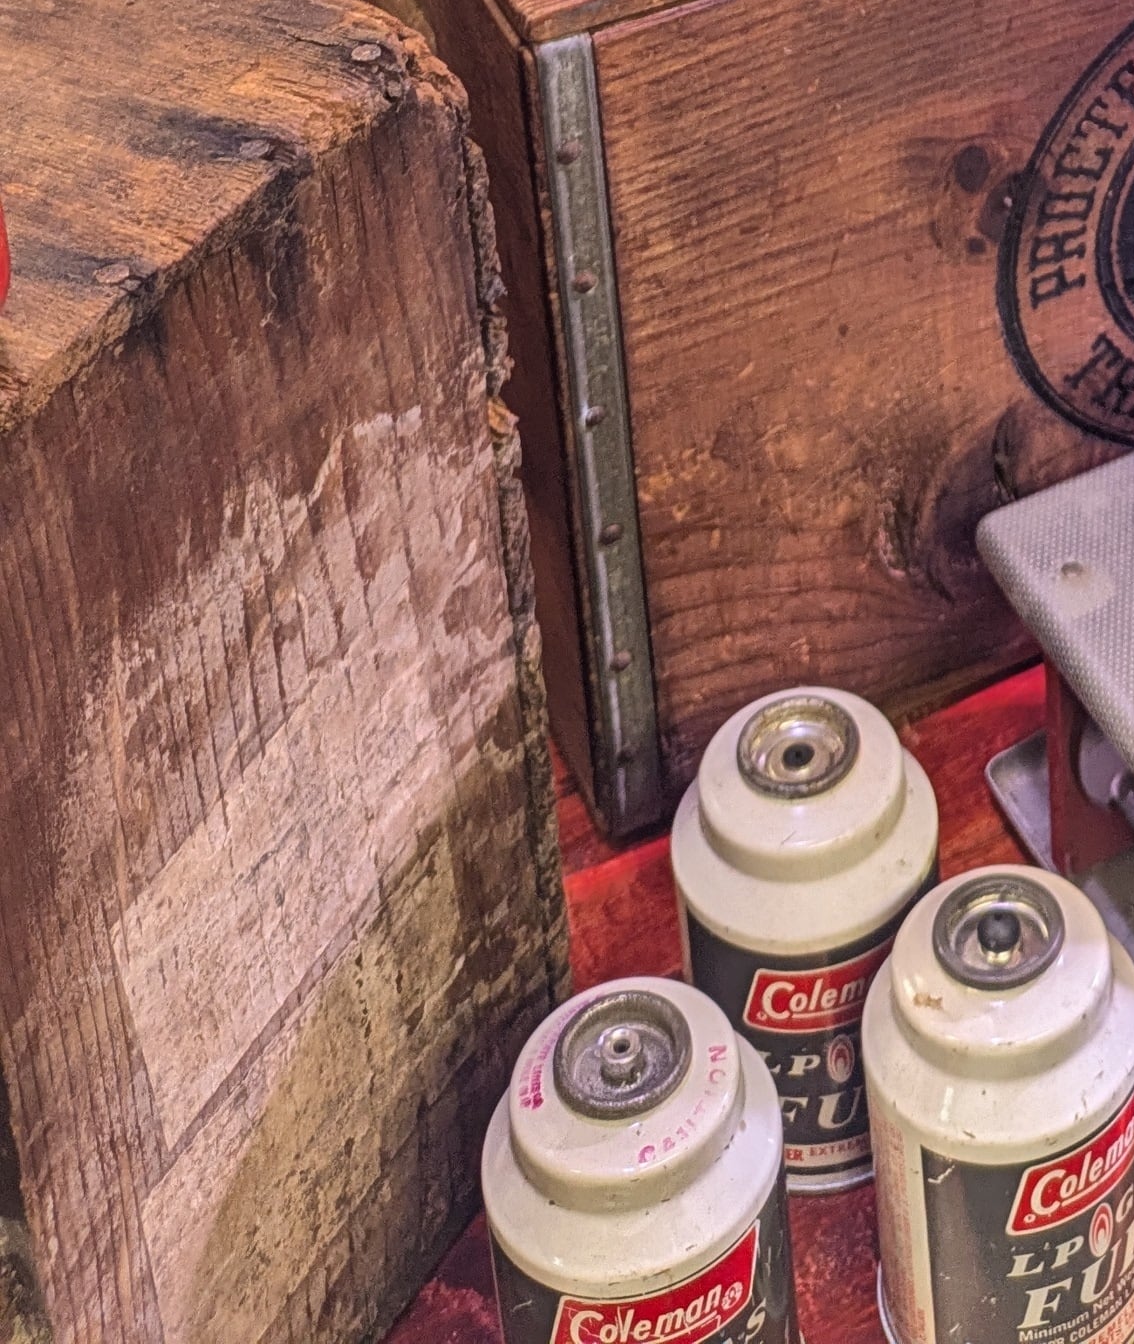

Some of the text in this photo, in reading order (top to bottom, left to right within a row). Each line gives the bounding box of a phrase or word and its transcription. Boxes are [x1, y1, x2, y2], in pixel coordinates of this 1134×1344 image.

[780, 1084, 864, 1131] FU
[569, 1283, 723, 1344] Coleman
[1018, 1290, 1115, 1343] Minimum Net
[1069, 1296, 1123, 1343] COLEMAN
